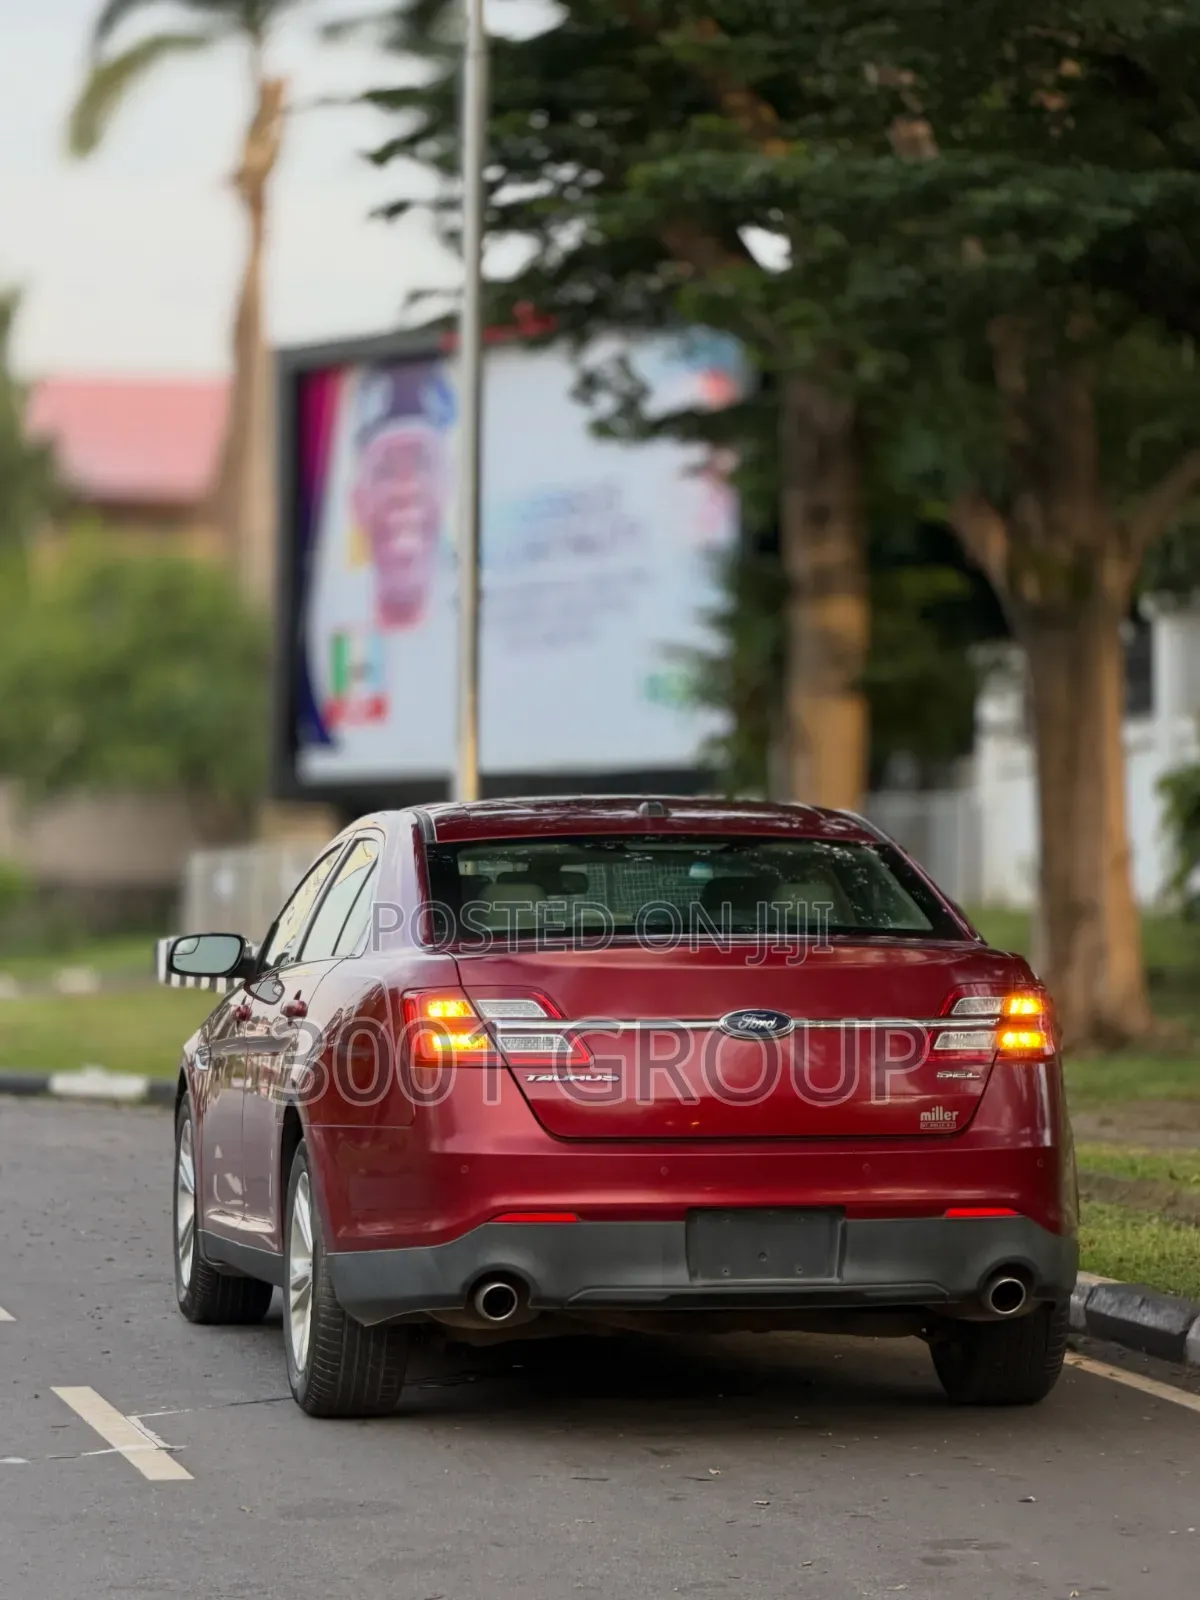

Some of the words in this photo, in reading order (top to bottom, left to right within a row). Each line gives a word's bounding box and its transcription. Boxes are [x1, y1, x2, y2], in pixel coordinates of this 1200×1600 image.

[738, 1013, 777, 1029] Ford
[524, 1074, 620, 1082] TAURUS
[920, 1105, 959, 1121] miller
